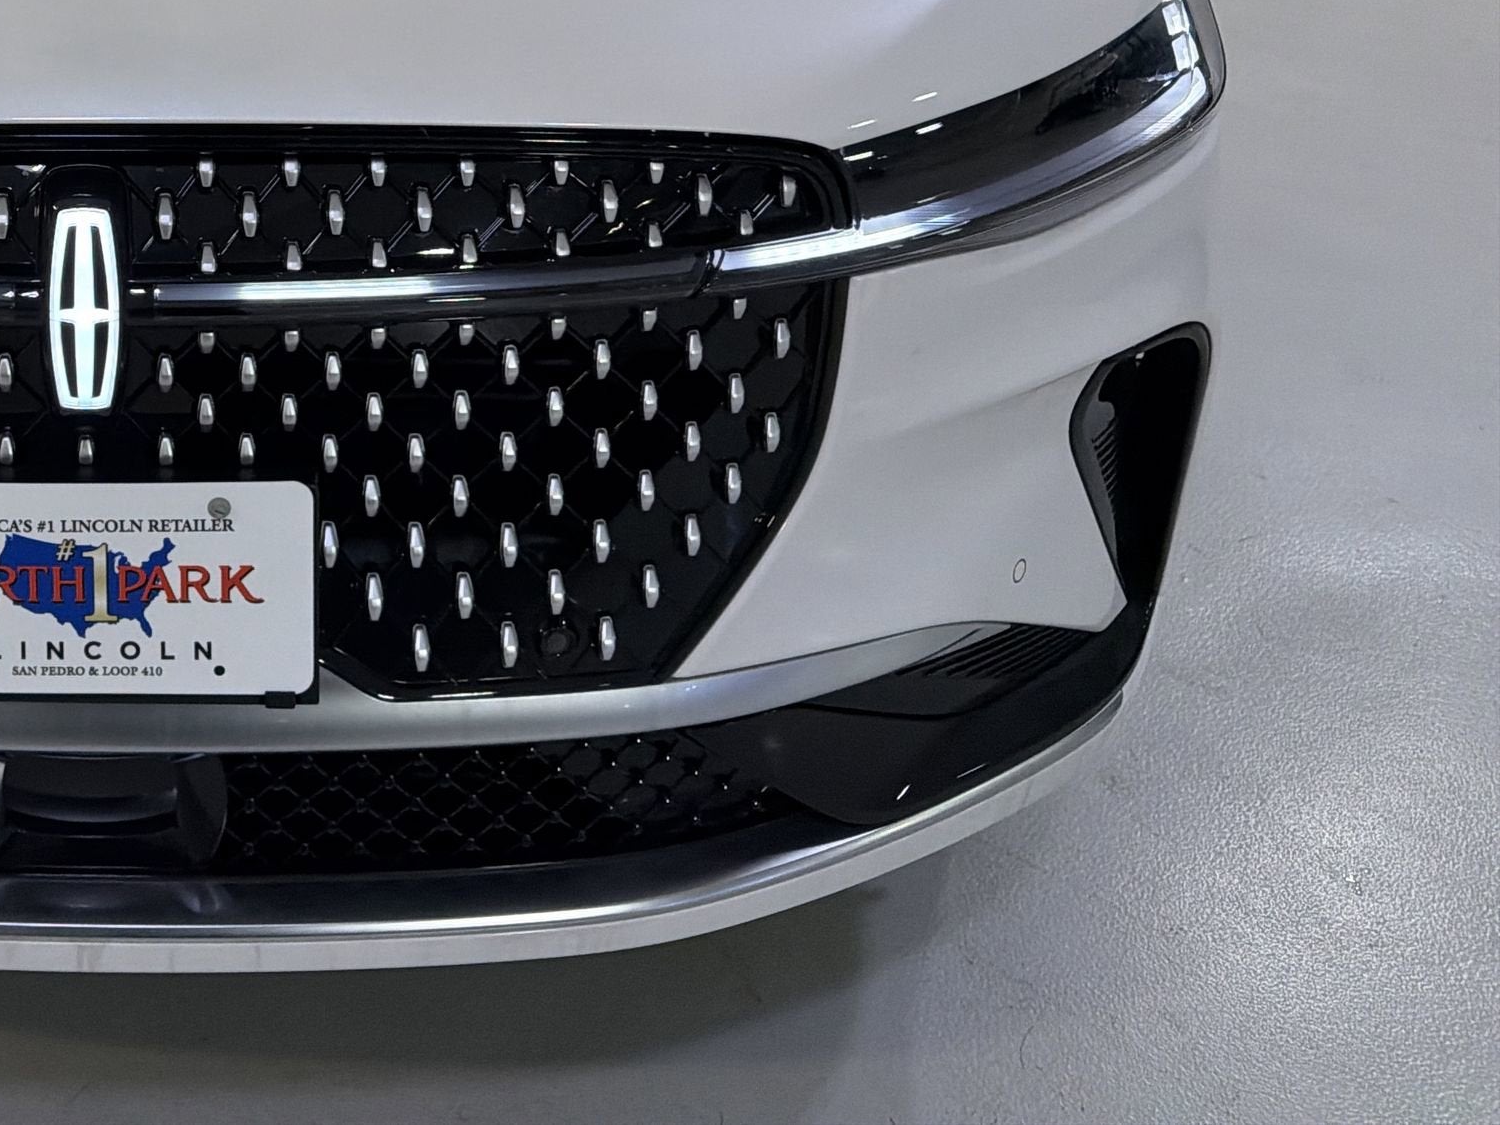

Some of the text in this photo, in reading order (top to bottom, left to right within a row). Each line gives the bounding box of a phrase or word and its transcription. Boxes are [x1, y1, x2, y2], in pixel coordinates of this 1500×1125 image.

[36, 519, 55, 533] #1
[61, 519, 143, 533] LINCOLN
[149, 518, 235, 533] RETAILER
[116, 564, 265, 605] PARK
[11, 665, 163, 677] SAN PEDRO & LOOP 410
